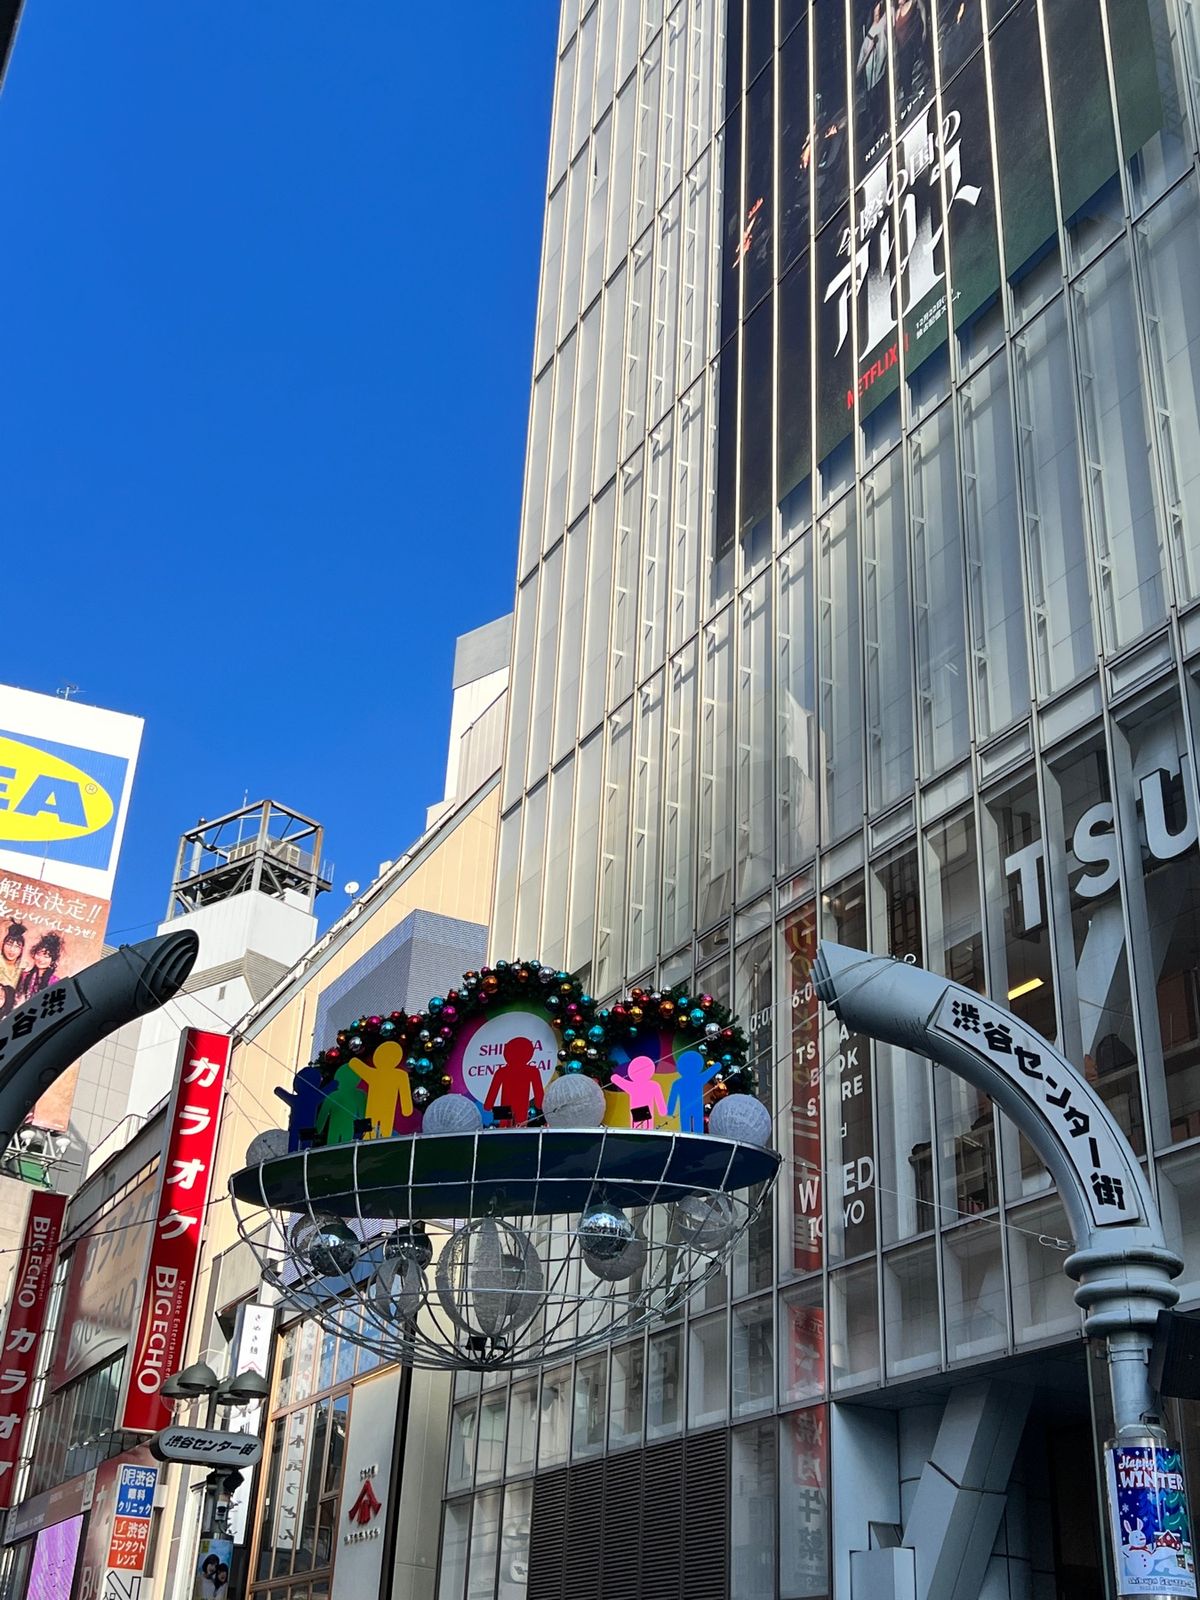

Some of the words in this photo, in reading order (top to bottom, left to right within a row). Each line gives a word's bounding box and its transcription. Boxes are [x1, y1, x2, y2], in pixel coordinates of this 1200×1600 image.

[479, 1040, 543, 1057] SHIA
[952, 1001, 1125, 1211] 渋谷センター街
[159, 1057, 220, 1240] カラオケ
[33, 1216, 51, 1252] BIG
[18, 1257, 43, 1309] ECHO
[154, 1265, 179, 1316] BIG
[174, 1279, 187, 1315] Karaoke
[137, 1320, 168, 1394] ECHO
[165, 1435, 257, 1456] 渋谷センター街
[136, 1469, 156, 1488] 渋谷
[1120, 1471, 1184, 1490] WINTER
[117, 1502, 152, 1515] クリニック
[127, 1521, 149, 1538] 渋谷
[111, 1539, 146, 1553] コンタクト
[116, 1553, 137, 1567] レンズ
